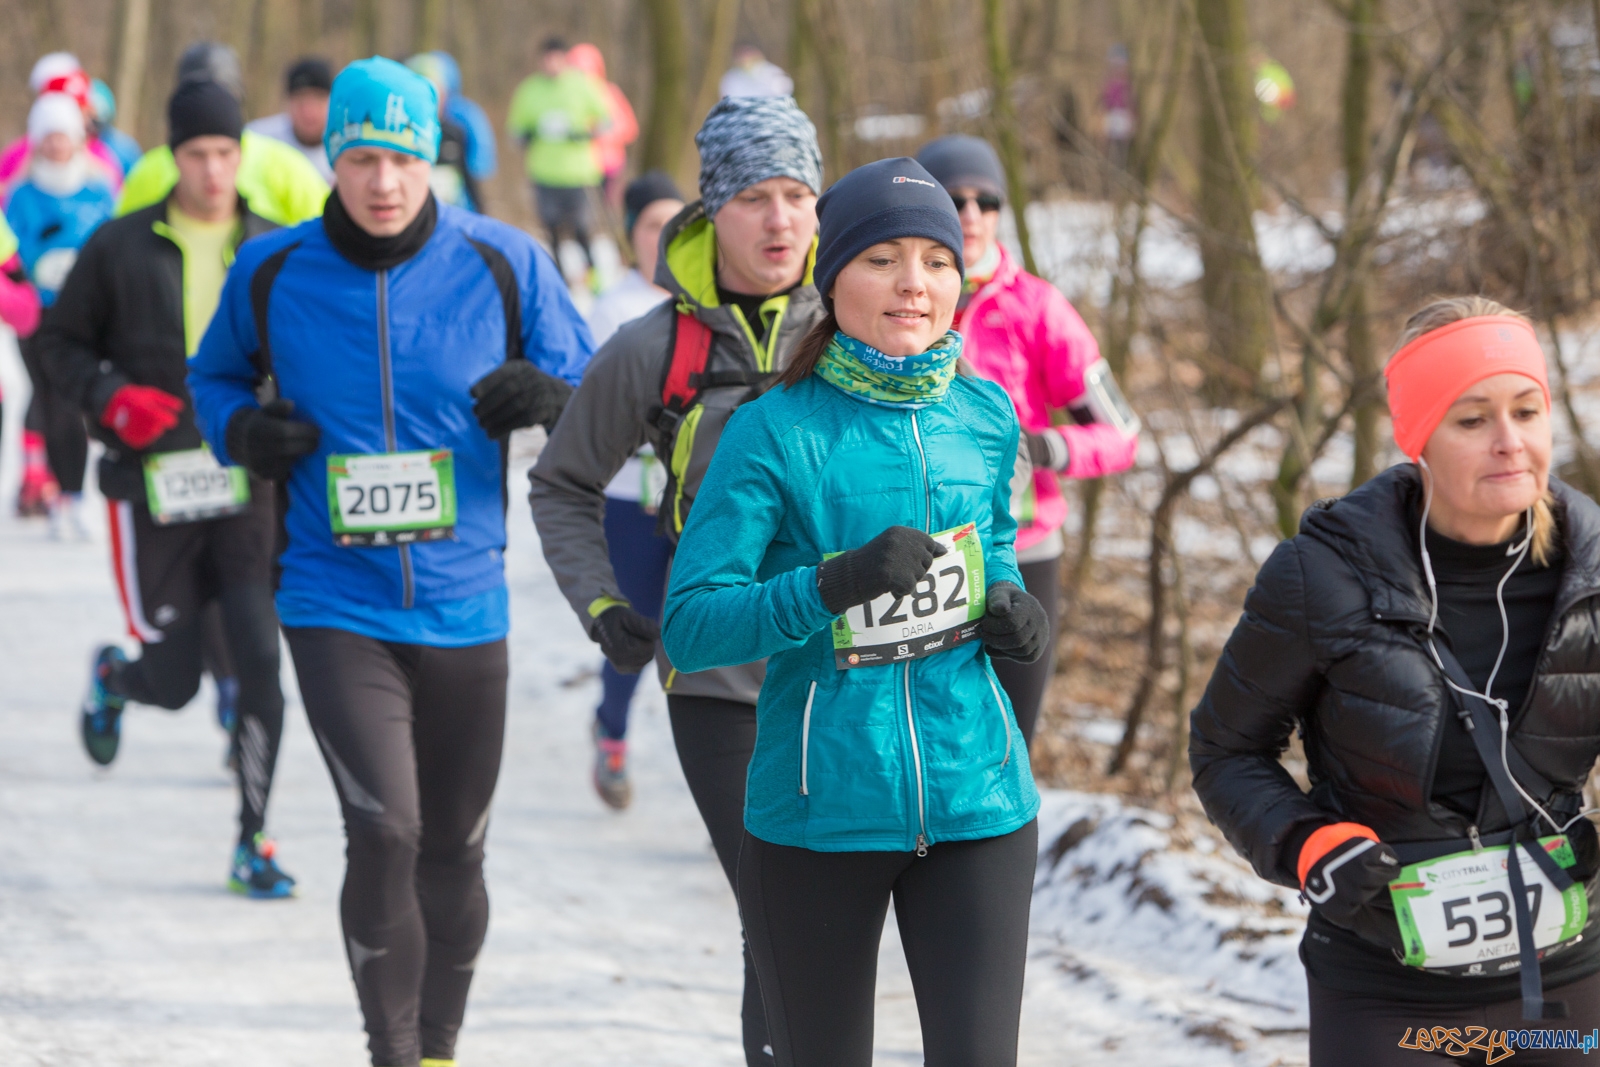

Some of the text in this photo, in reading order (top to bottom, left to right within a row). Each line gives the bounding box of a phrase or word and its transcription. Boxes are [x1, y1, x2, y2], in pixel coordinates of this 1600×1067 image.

[862, 353, 904, 371] FOREST
[345, 481, 436, 515] 2075
[862, 565, 967, 629] 1282
[973, 568, 981, 607] Poznań
[902, 621, 935, 638] DARIA
[1477, 942, 1518, 960] ANETA
